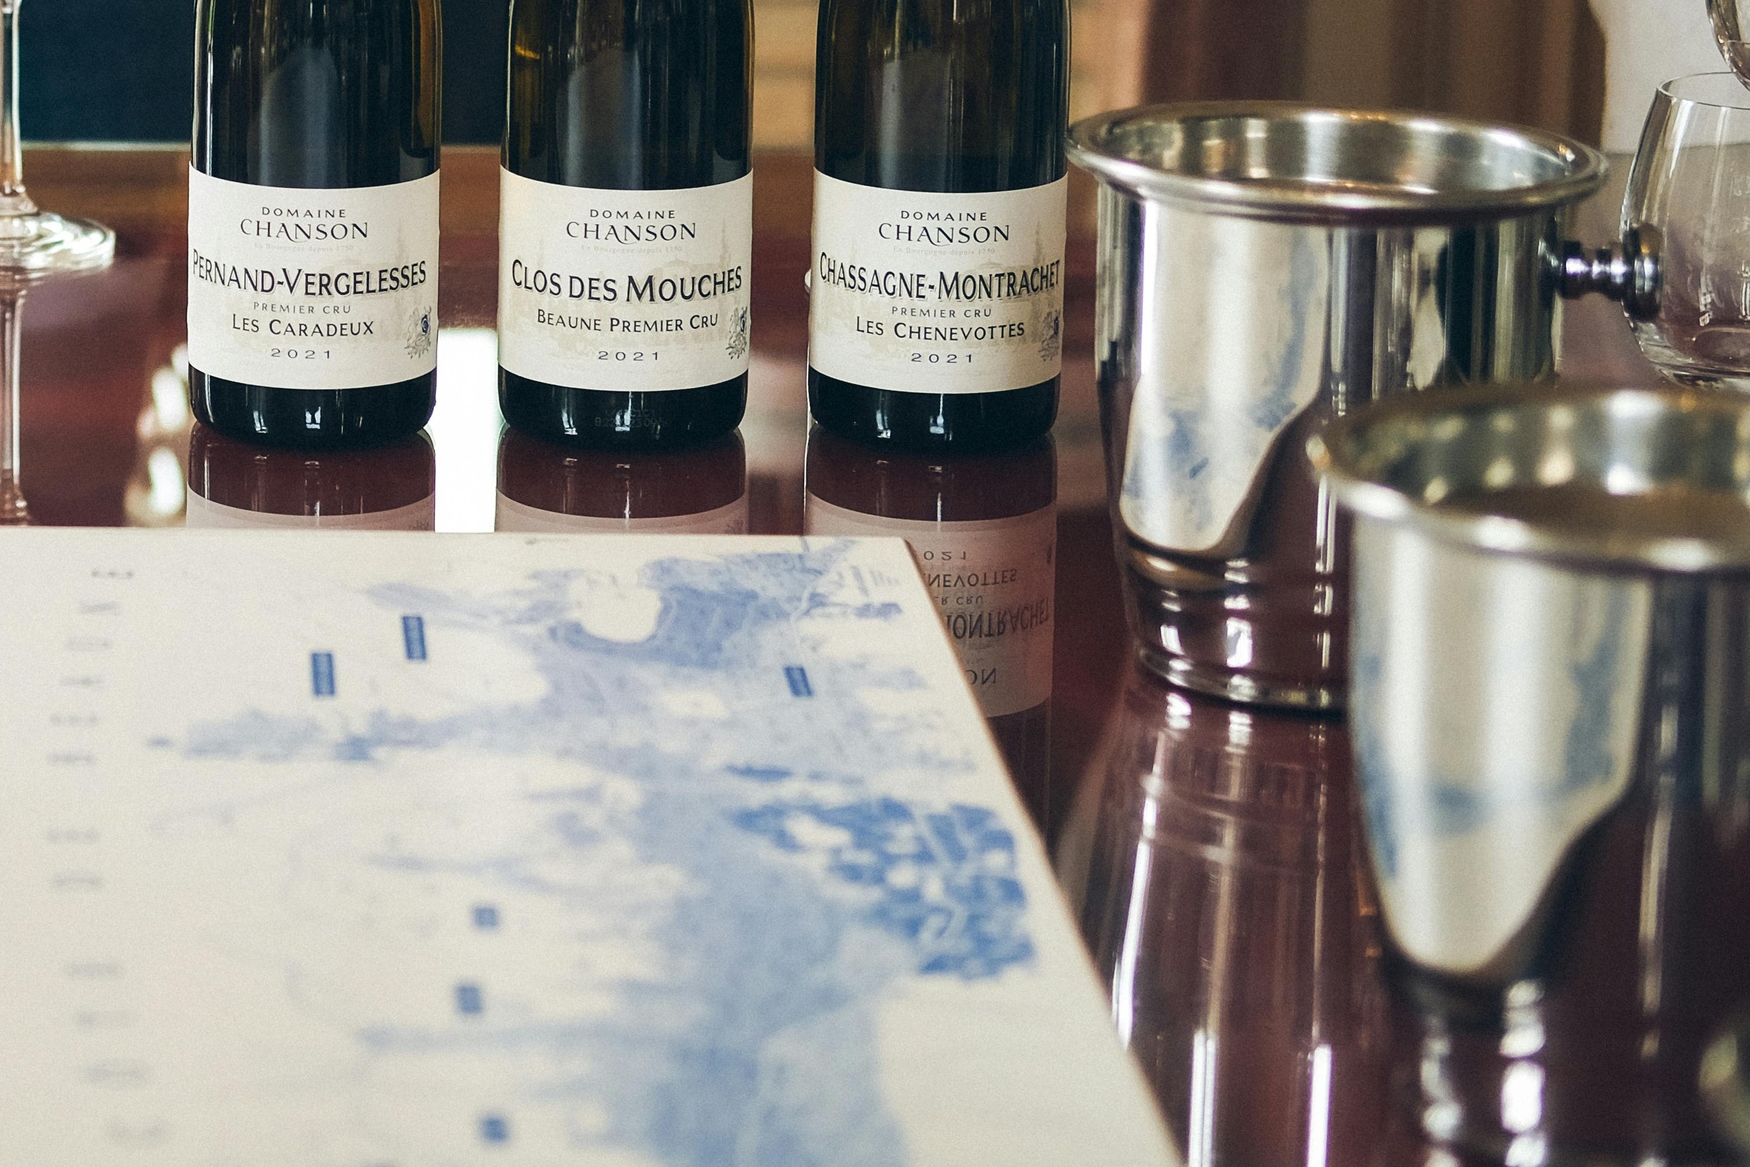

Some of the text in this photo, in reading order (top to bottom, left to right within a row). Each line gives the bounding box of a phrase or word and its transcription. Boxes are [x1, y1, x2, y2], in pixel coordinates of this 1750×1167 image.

[262, 206, 346, 218] DOMAINE
[590, 209, 675, 219] DOMAINE
[901, 210, 987, 221] DOMAINE
[240, 218, 368, 243] CHANSON
[566, 222, 696, 244] CHANSON
[879, 223, 1010, 246] CHANSON
[193, 249, 426, 296] PERNAND-VERGELESSES
[512, 259, 742, 302] CLOS DES MOUCHES
[820, 252, 1060, 300] CHASSAGNE-MONTRACHET
[254, 302, 351, 314] PREMIER CRU
[892, 306, 992, 318] PREMIER CRU
[233, 314, 374, 337] LES CARADEUX
[537, 309, 718, 333] BEAUNE PREMIER CRU
[856, 316, 1025, 341] LES CHENEVOTTES
[271, 348, 331, 359] 2021
[598, 351, 659, 361] 2021
[911, 353, 973, 363] 2021
